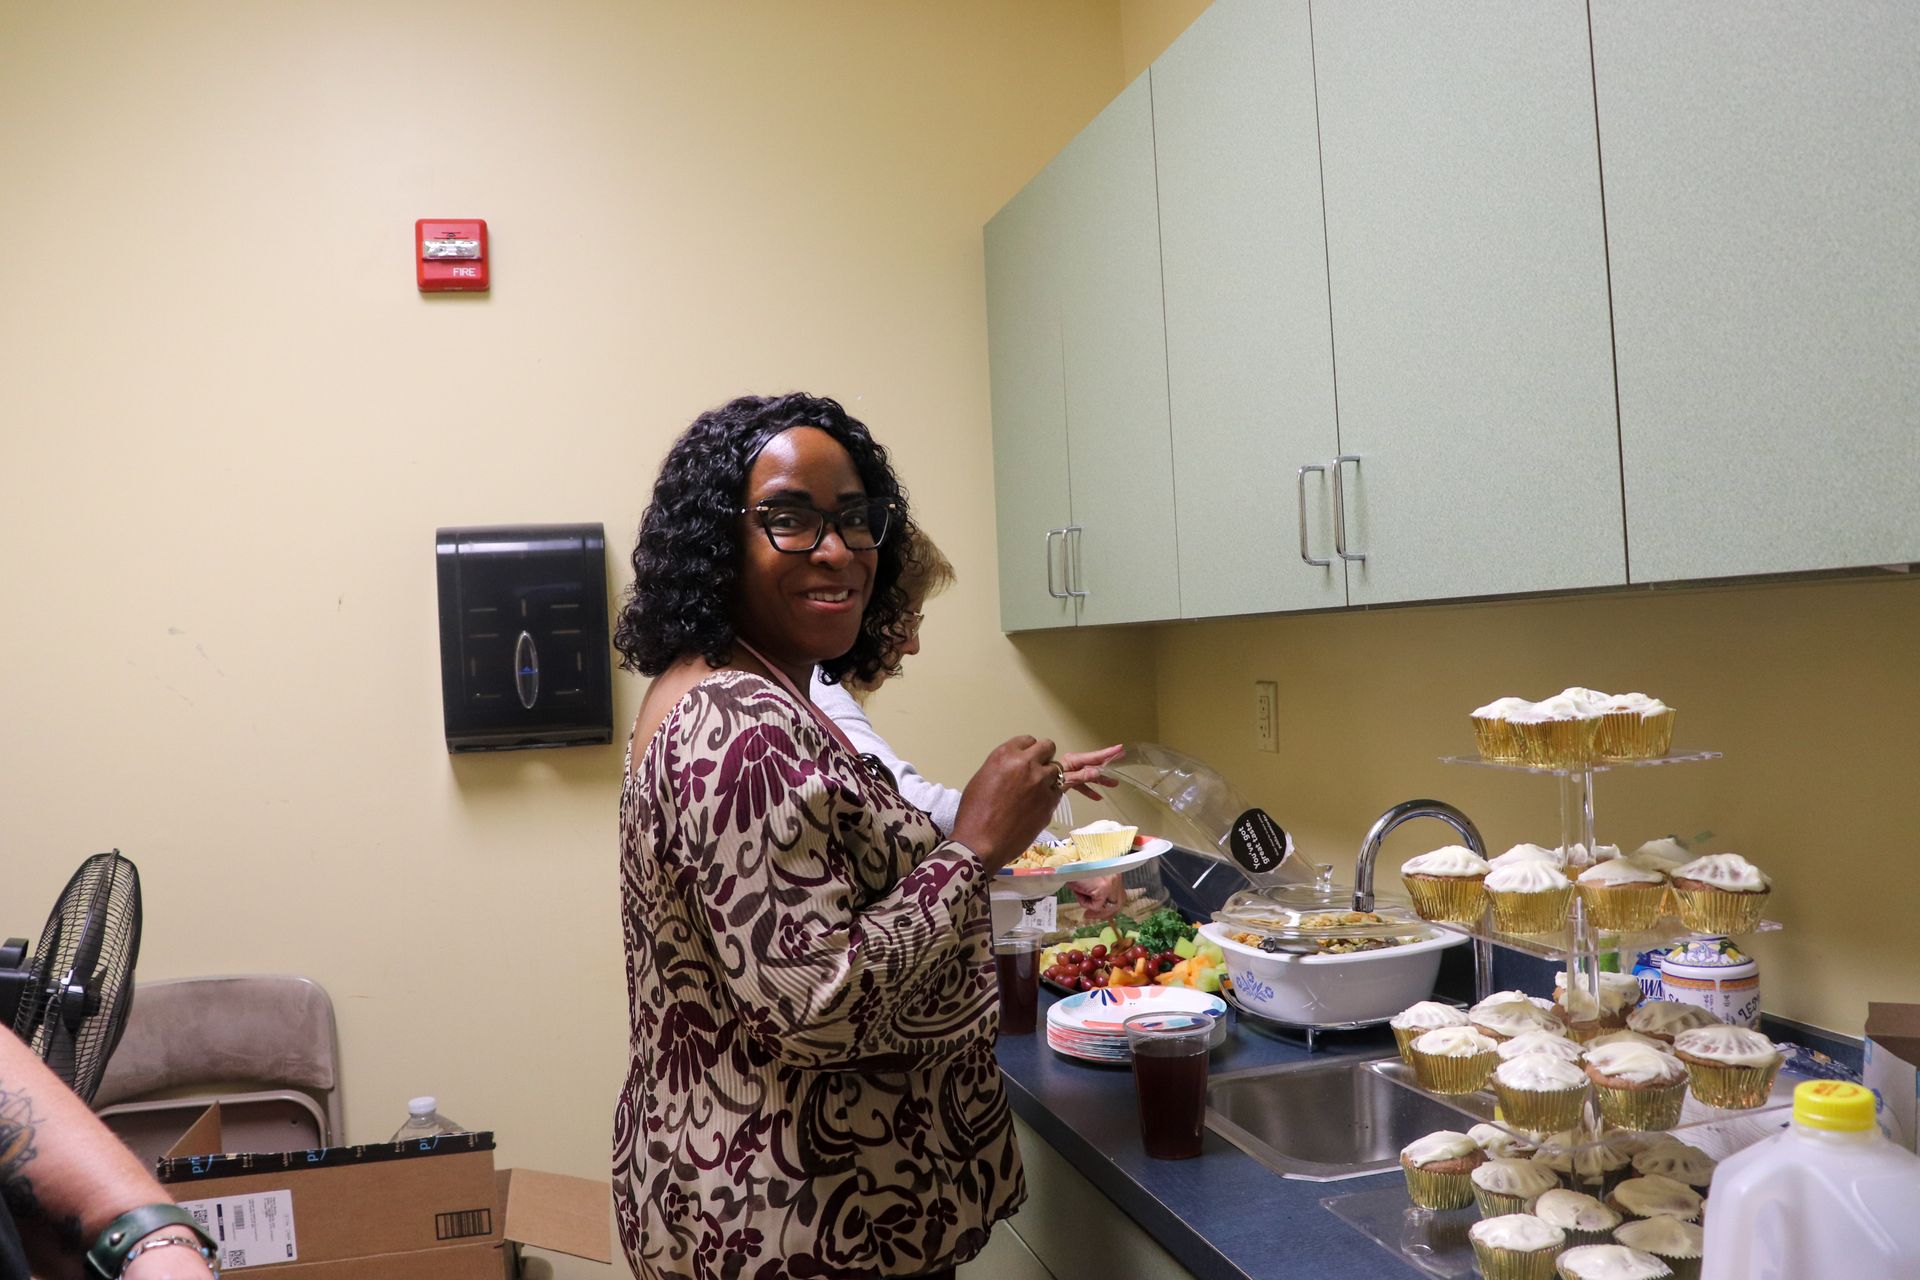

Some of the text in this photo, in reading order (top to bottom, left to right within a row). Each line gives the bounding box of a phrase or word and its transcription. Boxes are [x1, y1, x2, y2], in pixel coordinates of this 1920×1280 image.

[453, 267, 476, 277] FIRE
[1245, 820, 1258, 843] taste.
[1238, 826, 1260, 869] You've got
[1255, 842, 1270, 864] great
